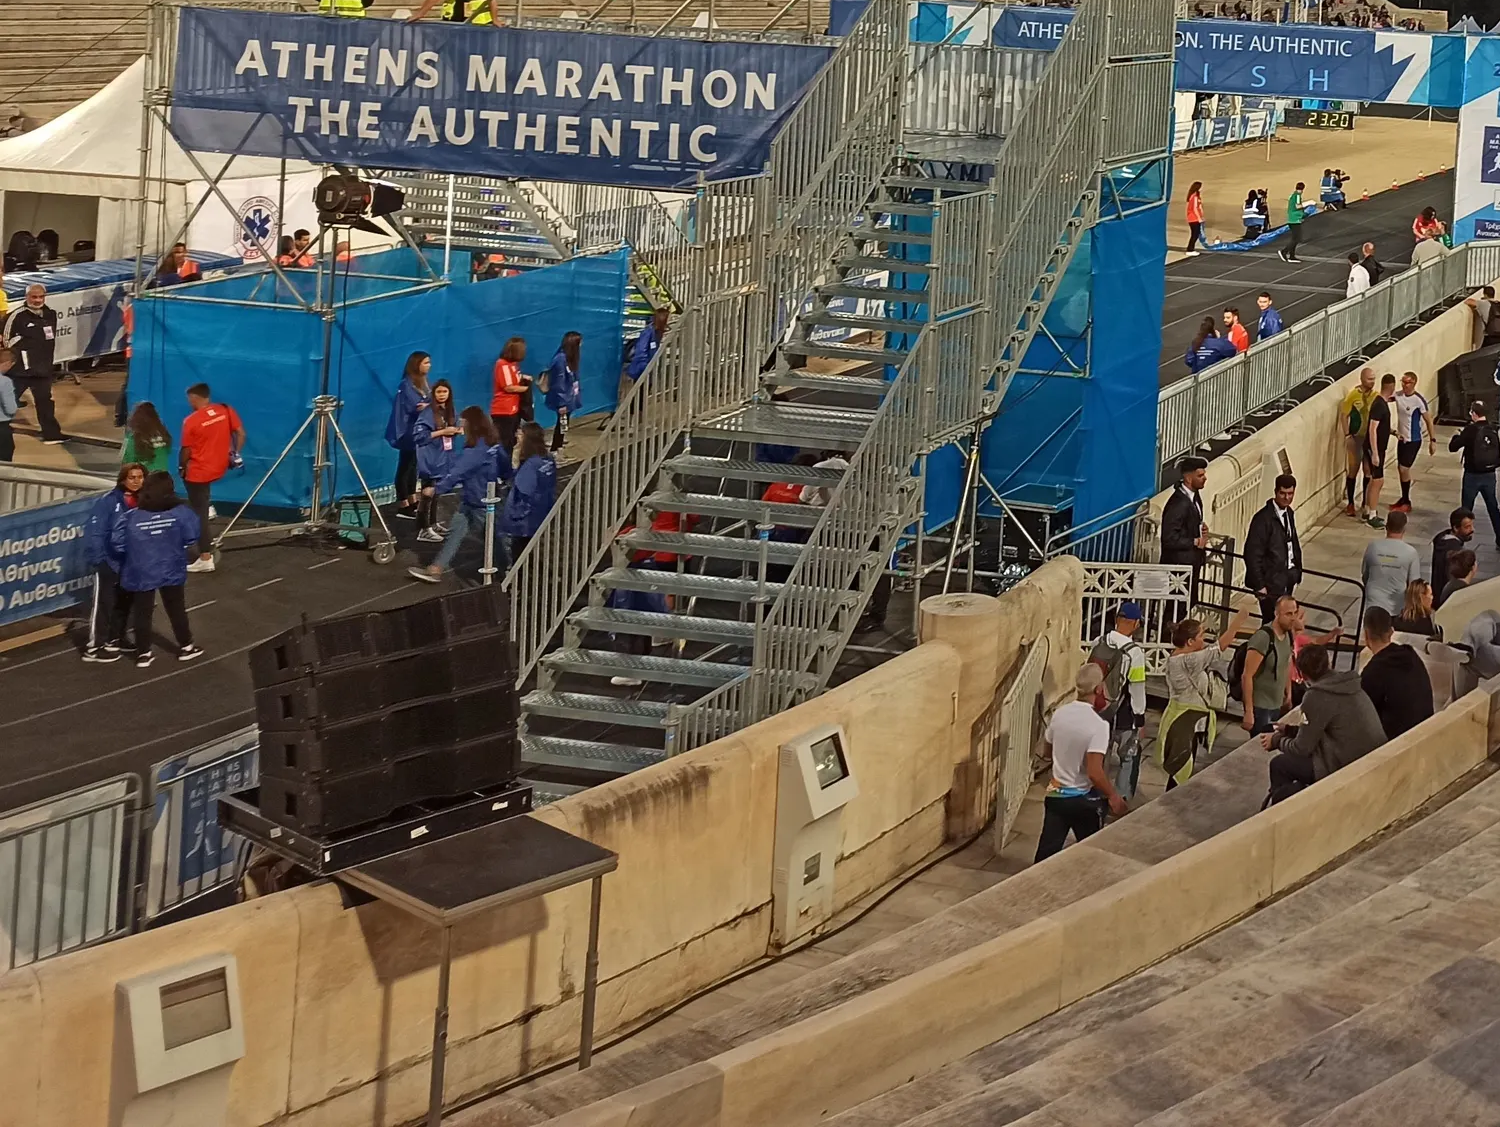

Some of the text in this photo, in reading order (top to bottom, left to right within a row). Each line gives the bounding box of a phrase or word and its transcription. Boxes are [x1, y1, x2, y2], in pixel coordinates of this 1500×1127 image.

[234, 39, 777, 111] ATHENS MARATHON
[1209, 32, 1244, 52] THE
[1248, 35, 1353, 57] AUTHENTIC
[287, 96, 718, 163] THE AUTHENTIC
